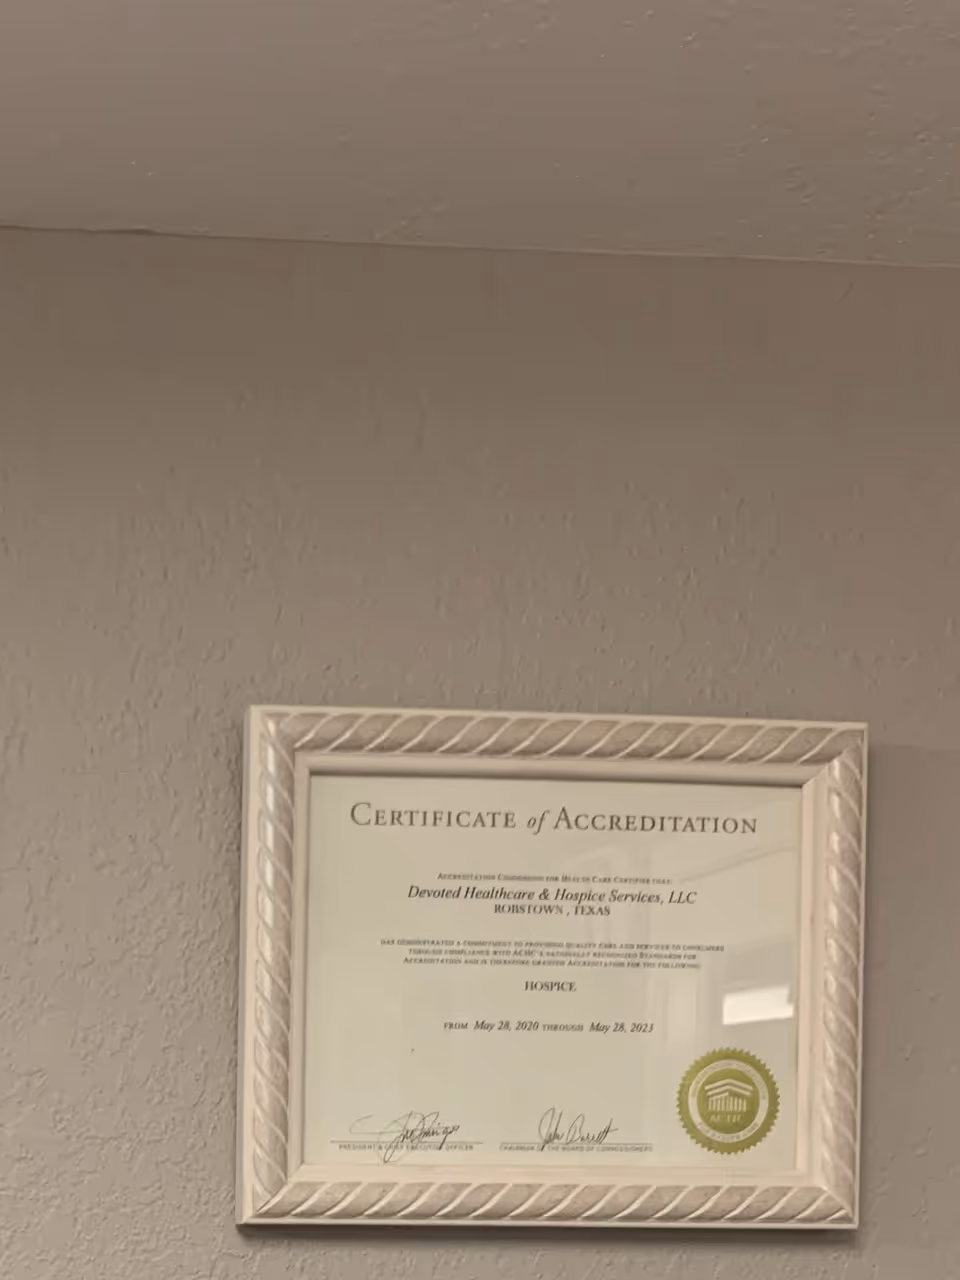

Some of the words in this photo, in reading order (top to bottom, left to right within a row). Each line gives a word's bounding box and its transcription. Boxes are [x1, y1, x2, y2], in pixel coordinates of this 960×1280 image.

[350, 802, 516, 828] CERTIFICATE
[527, 809, 550, 835] of
[553, 806, 758, 834] ACCREDITATION
[408, 885, 462, 898] Devoted
[464, 886, 534, 900] Healthcare
[538, 888, 549, 901] &
[554, 888, 605, 904] Hospice
[608, 889, 663, 904] Services,
[668, 890, 696, 904] LLC
[525, 981, 576, 991] HOSPICE
[473, 1020, 495, 1032] May
[497, 1020, 511, 1031] 28,
[515, 1020, 539, 1031] 2020
[589, 1022, 610, 1034] May
[612, 1022, 626, 1033] 28,
